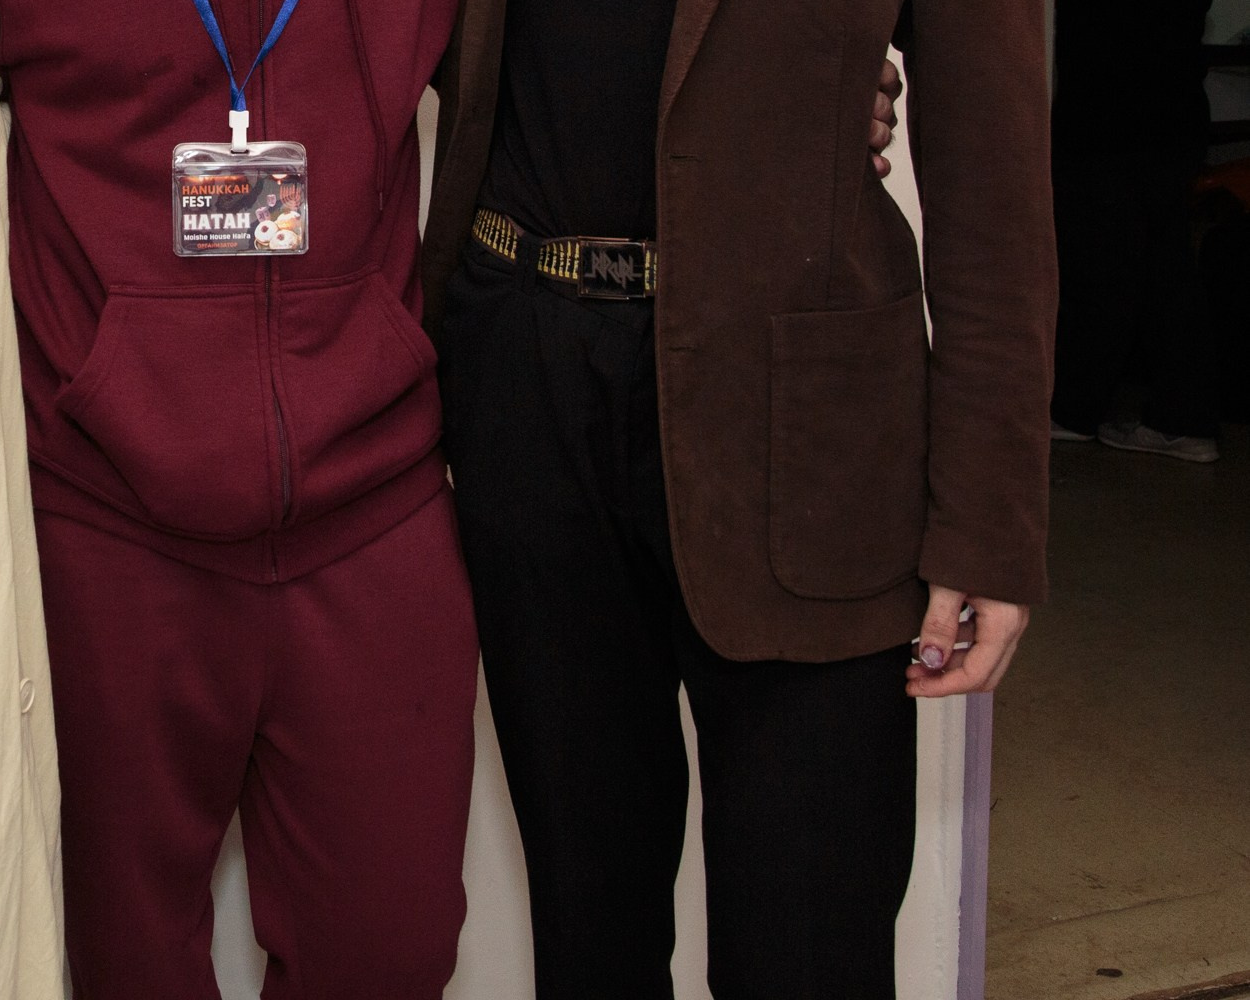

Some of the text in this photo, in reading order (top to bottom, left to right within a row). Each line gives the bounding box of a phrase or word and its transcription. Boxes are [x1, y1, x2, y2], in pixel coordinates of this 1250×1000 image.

[182, 184, 249, 194] HANUKKAH
[183, 196, 212, 207] FEST
[183, 213, 250, 230] НАТАН
